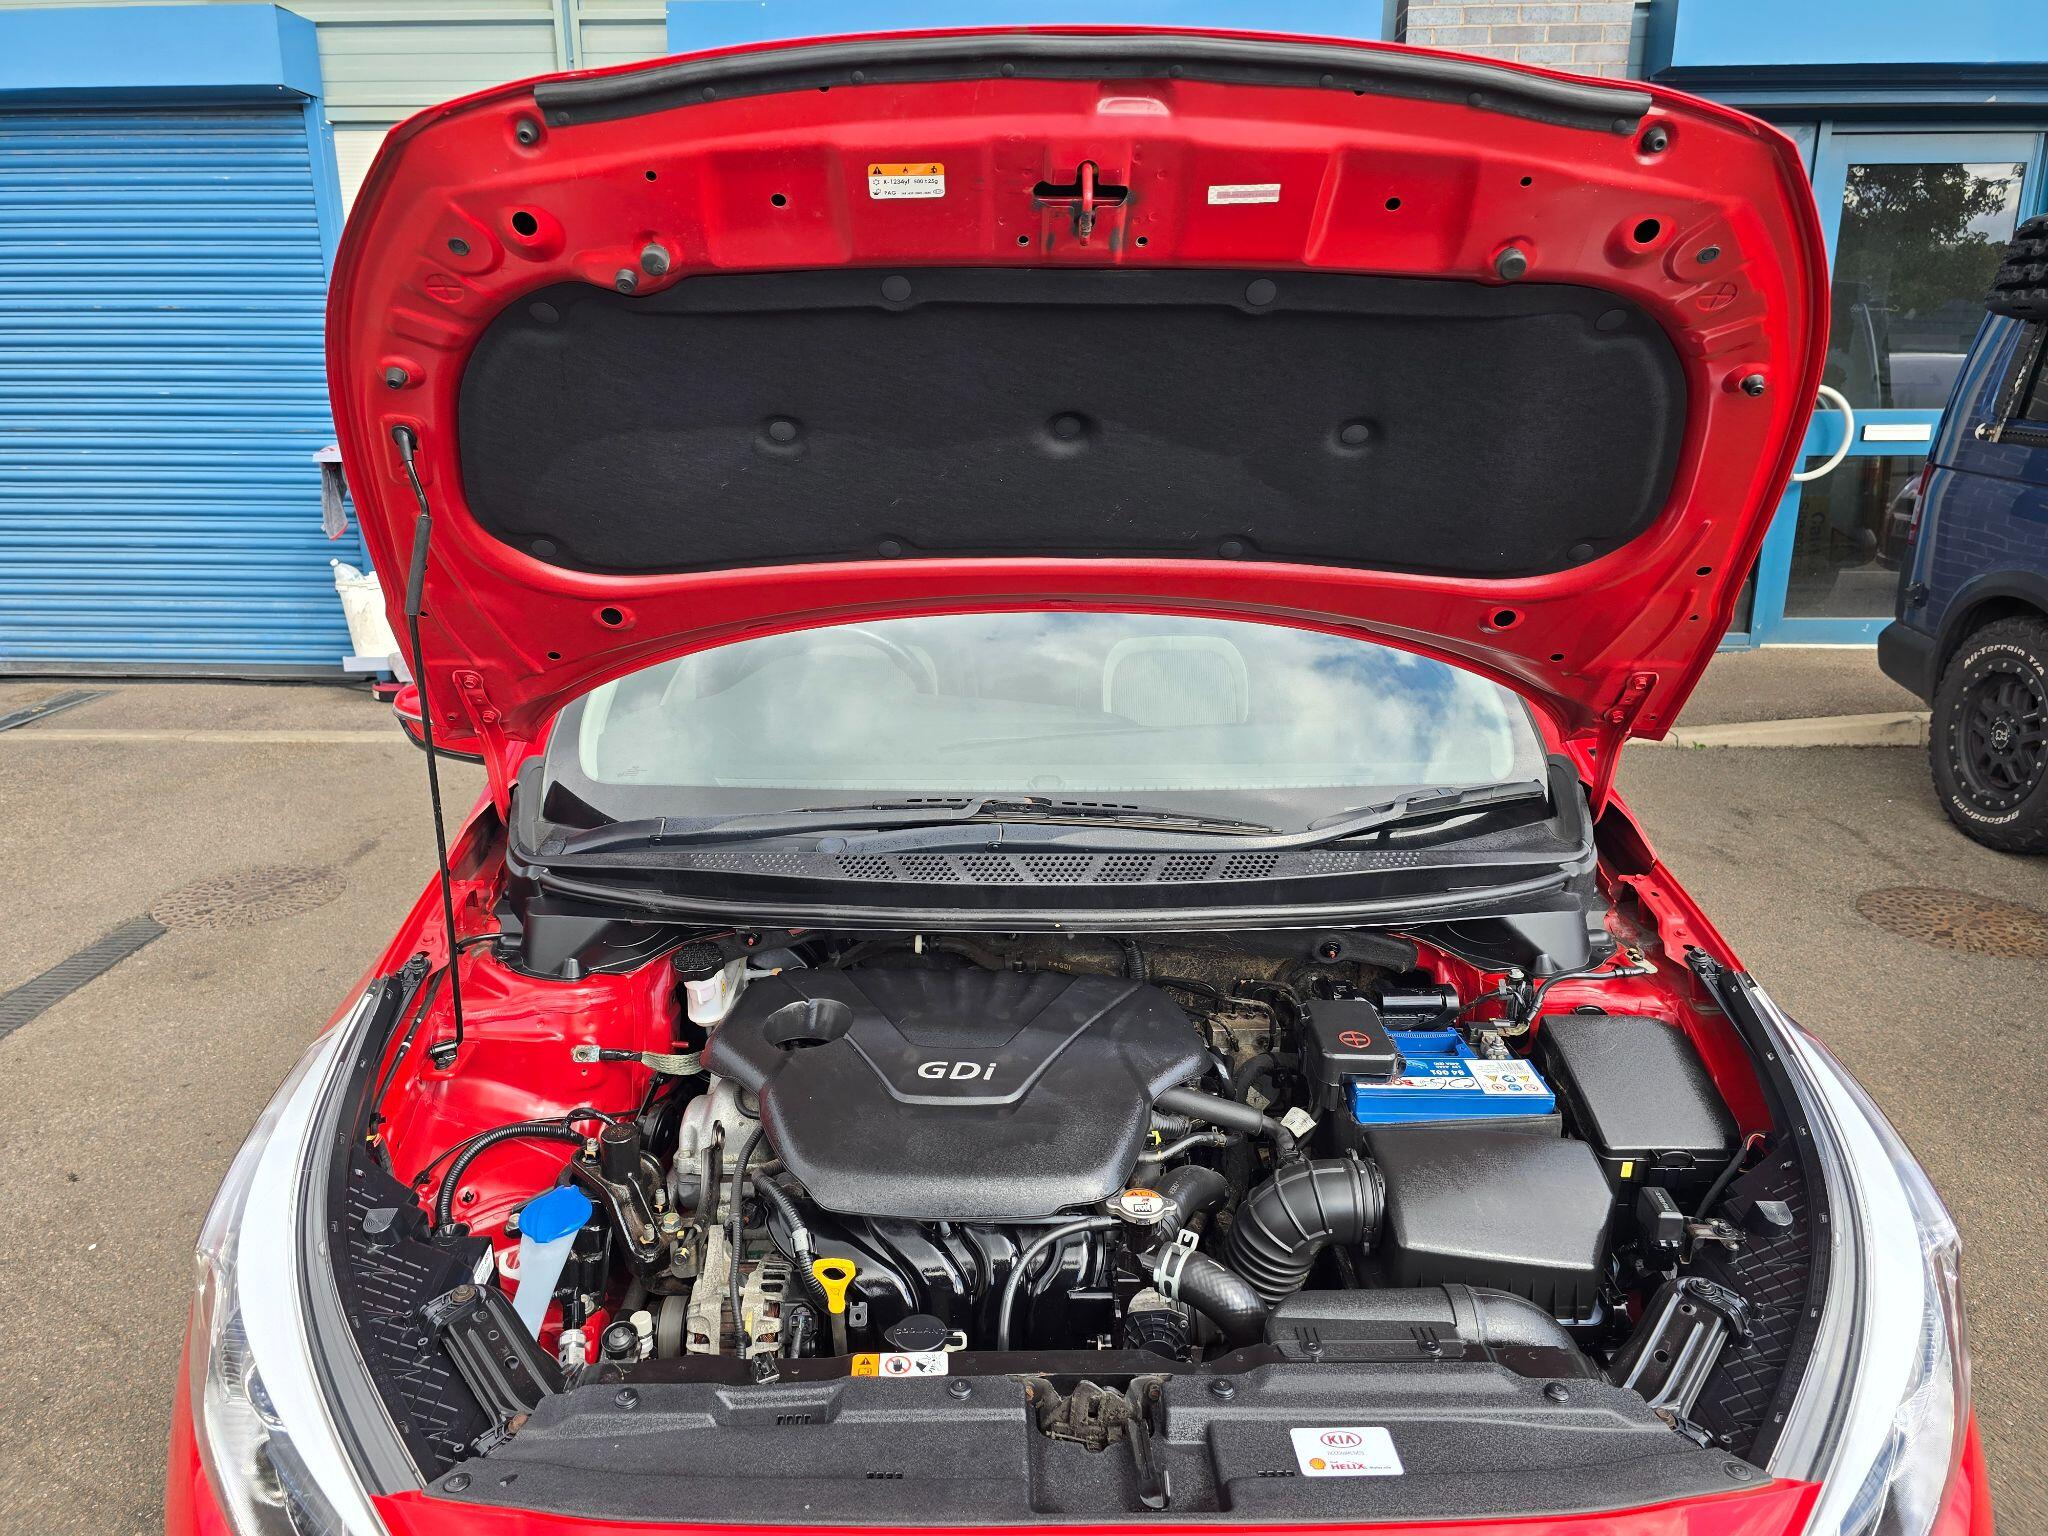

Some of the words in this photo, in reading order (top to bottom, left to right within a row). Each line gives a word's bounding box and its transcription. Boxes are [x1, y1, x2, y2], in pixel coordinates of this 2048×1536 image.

[1963, 644, 2025, 669] All-Terrain
[2029, 655, 2045, 676] T/A
[1952, 795, 2020, 825] BFGoodrich
[917, 1061, 997, 1081] GDi
[1326, 1434, 1357, 1445] KIA
